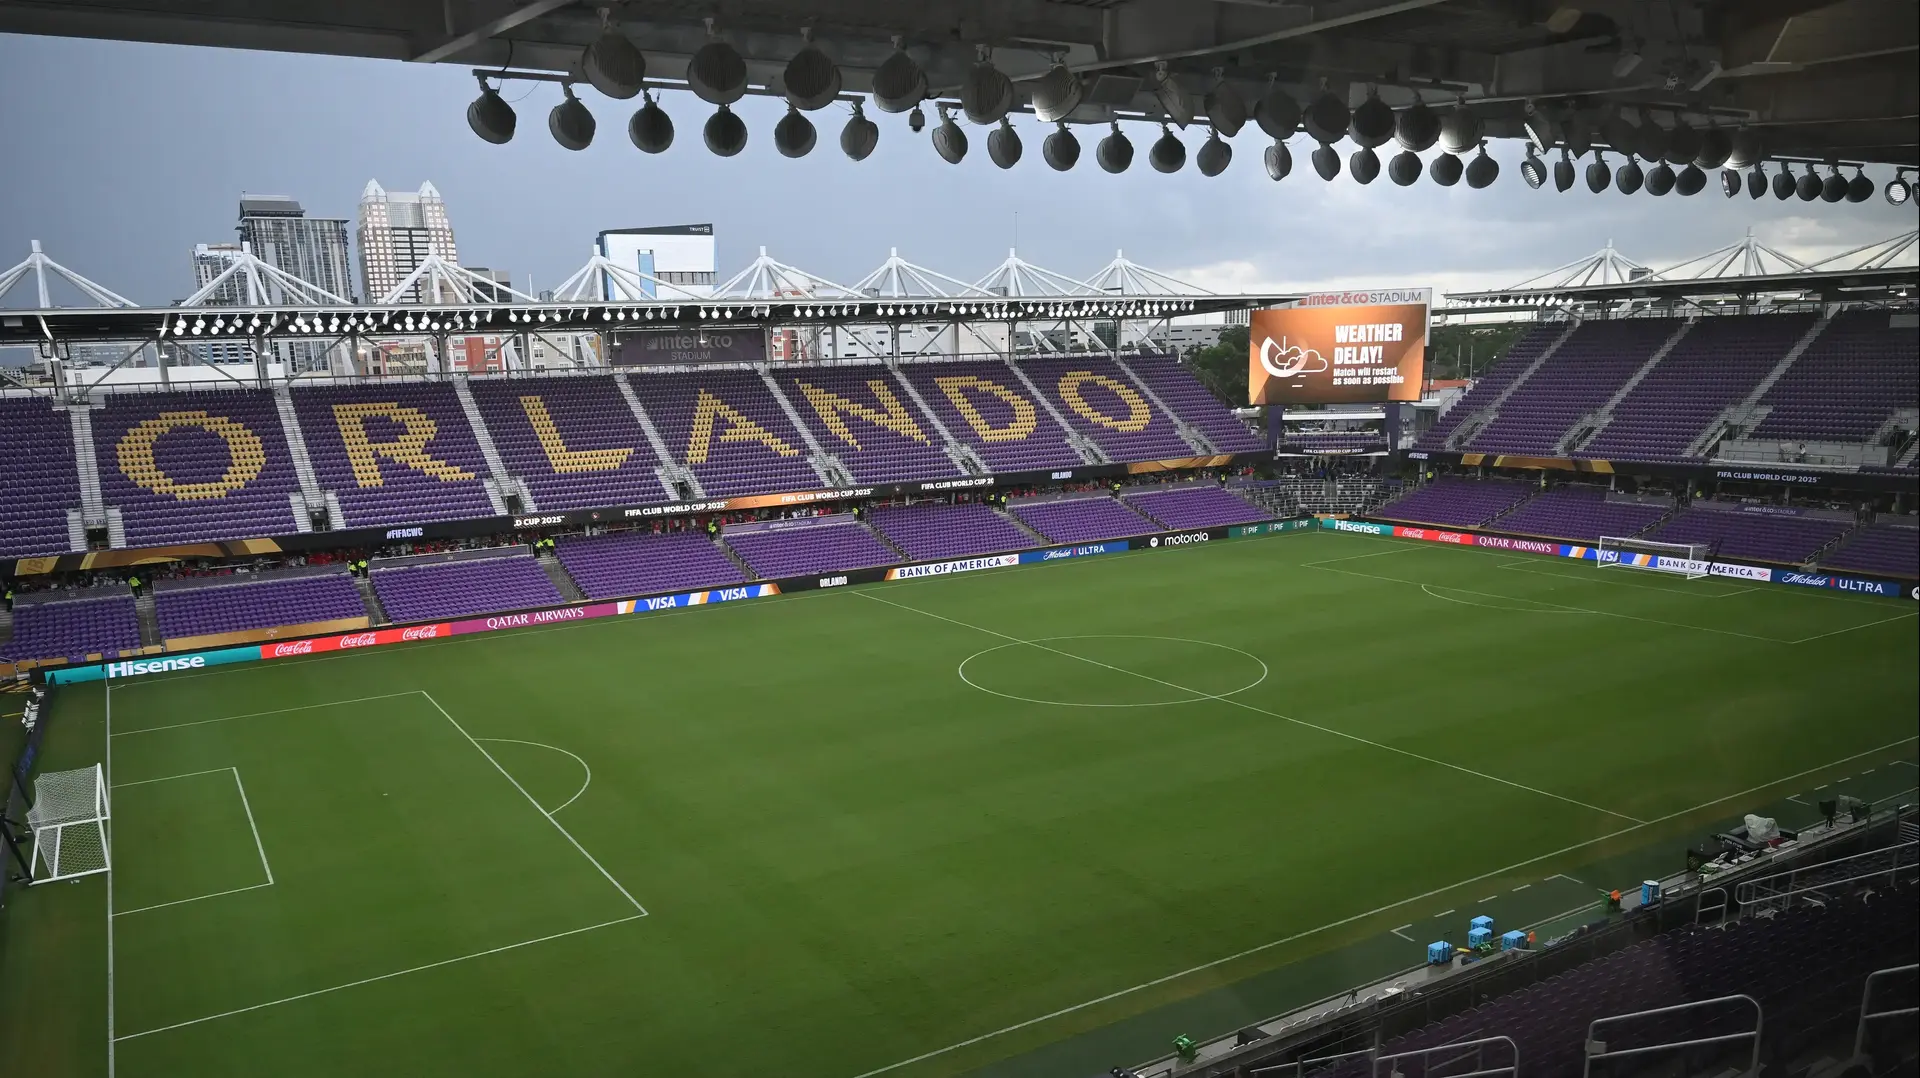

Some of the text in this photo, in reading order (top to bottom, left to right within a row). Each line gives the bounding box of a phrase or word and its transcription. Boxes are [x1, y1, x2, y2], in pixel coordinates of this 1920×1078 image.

[1308, 291, 1421, 306] inter&co STADIUM
[1335, 323, 1403, 343] WEATHER
[671, 351, 711, 360] STADIUM
[1334, 345, 1383, 365] DELAY!
[1333, 366, 1398, 377] Match will restart
[1332, 375, 1404, 385] as soon as possible
[1051, 470, 1073, 480] ORLANDO
[1753, 473, 1781, 481] WORLD
[921, 483, 935, 491] FIFA
[935, 481, 951, 490] CLUB
[951, 479, 974, 488] WORLD
[974, 479, 987, 487] CUP
[781, 495, 796, 503] FIFA
[797, 493, 816, 502] CLUB
[816, 491, 841, 501] WORLD
[841, 489, 854, 499] CUP
[625, 509, 642, 517] FIFA
[642, 507, 662, 516] CLUB
[663, 505, 690, 515] WORLD
[691, 503, 707, 513] CUP
[523, 517, 540, 526] CUP
[1274, 523, 1284, 531] PIF
[1300, 520, 1309, 528] PIF
[1335, 520, 1381, 535] Hisense
[386, 527, 424, 540] #FIFACWC
[1248, 526, 1258, 534] PIF
[1164, 531, 1209, 546] motorola
[1479, 536, 1552, 553] QATAR AIRWAYS
[1043, 545, 1105, 561] Michelob ULTRA
[899, 557, 1001, 578] BANK OF AMERICA
[1659, 558, 1687, 569] BANK
[1689, 562, 1702, 571] OF
[819, 575, 848, 588] ORLANDO
[1782, 572, 1884, 594] Michelob ULTRA
[718, 587, 748, 601] VISA
[647, 595, 676, 610] VISA
[486, 607, 585, 630] QATAR AIRWAYS
[108, 655, 205, 678] Hisense
